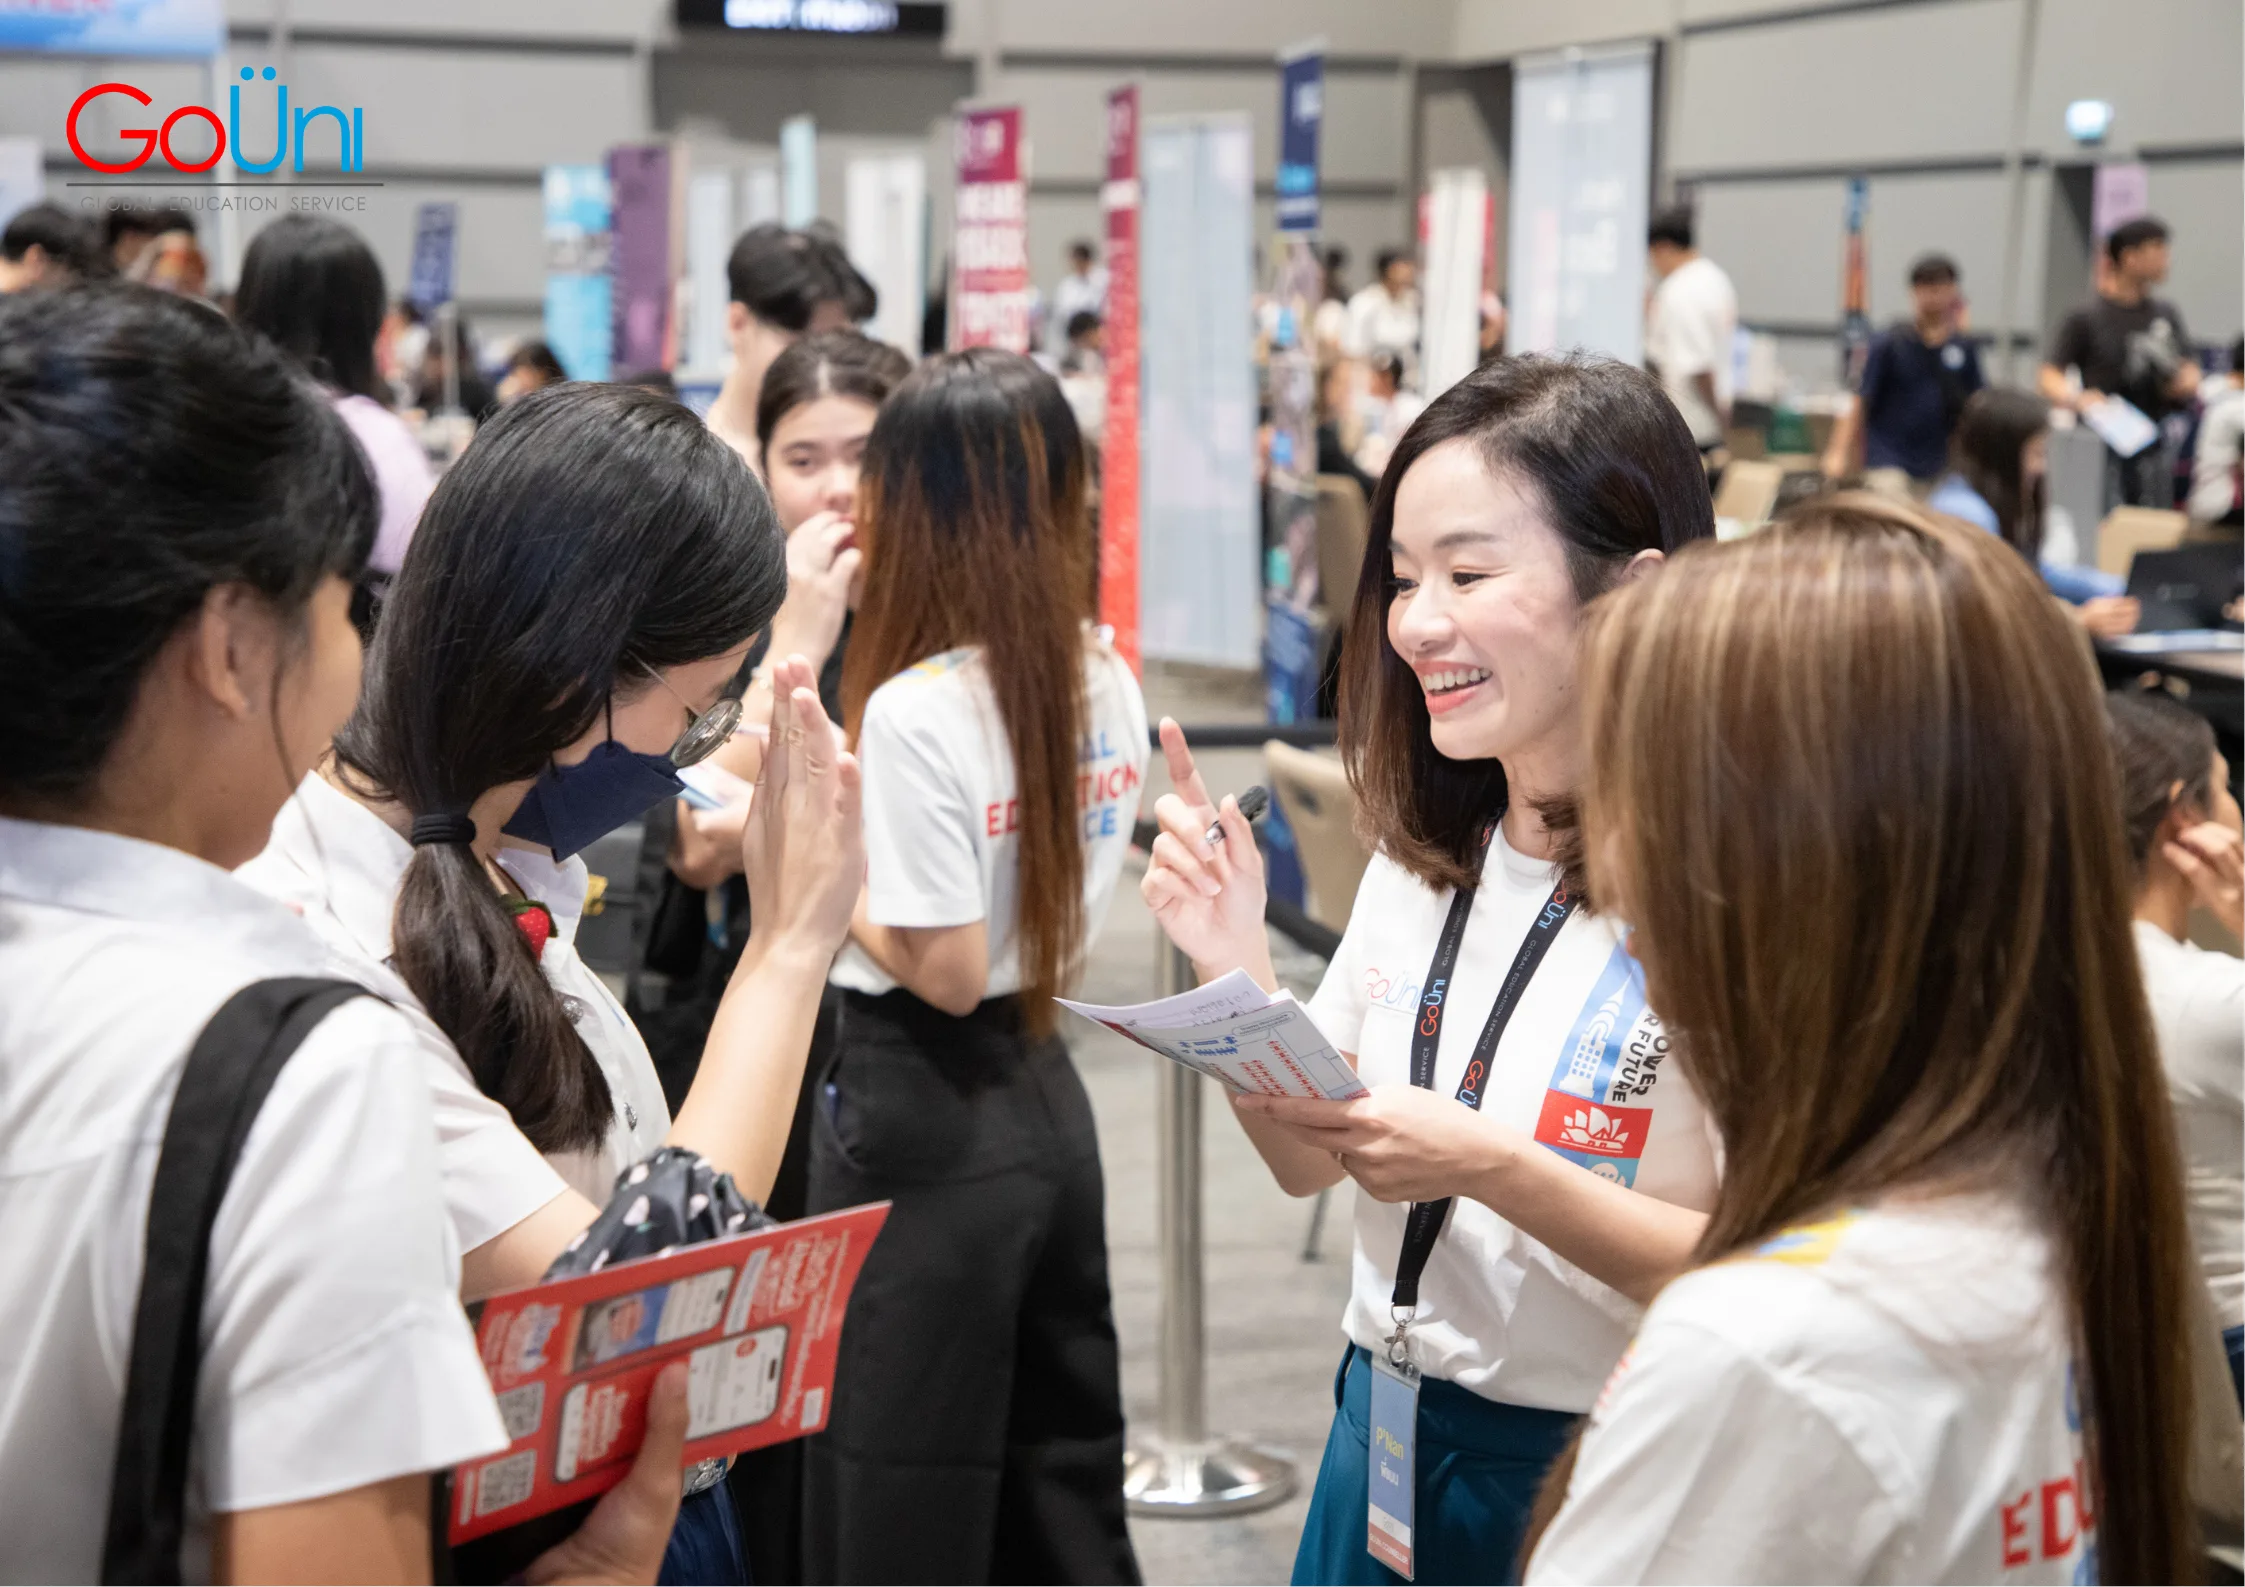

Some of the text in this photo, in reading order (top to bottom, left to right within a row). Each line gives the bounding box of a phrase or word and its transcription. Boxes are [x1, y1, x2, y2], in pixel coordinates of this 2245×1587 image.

[1441, 934, 1456, 967] GLOBAL
[1480, 939, 1537, 1051] GLOBAL EDUCATION SERVICE
[1419, 1046, 1431, 1081] SERVICE
[1459, 1059, 1485, 1108] GoÜ
[1611, 1028, 1653, 1103] FUTURE
